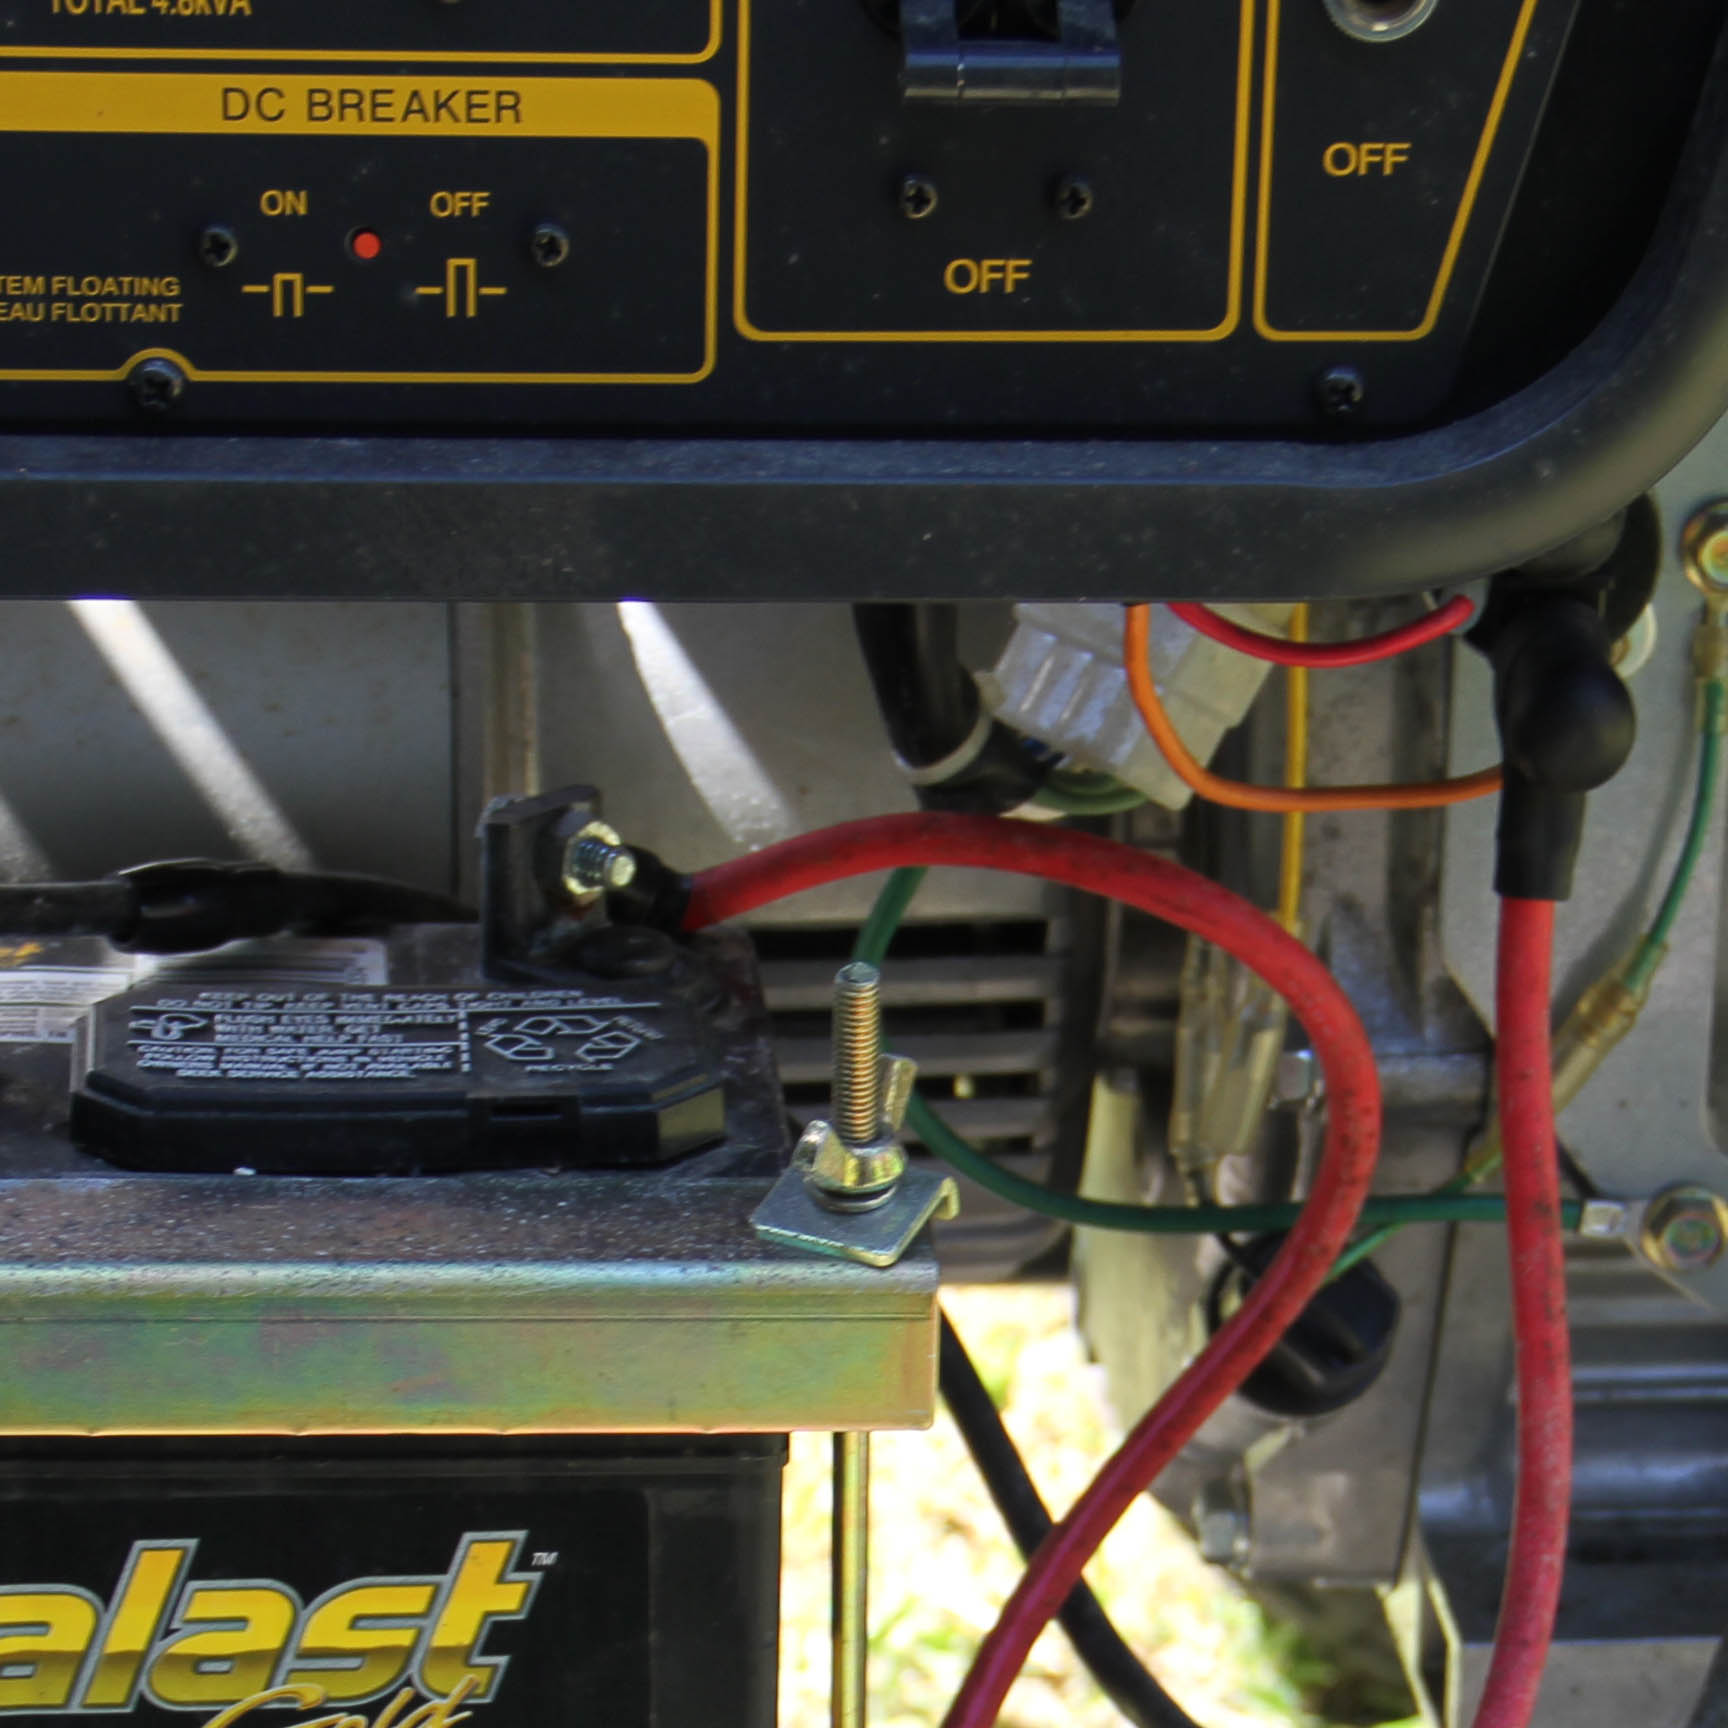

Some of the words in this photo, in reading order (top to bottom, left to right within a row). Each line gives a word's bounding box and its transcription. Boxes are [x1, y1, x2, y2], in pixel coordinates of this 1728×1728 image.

[221, 87, 285, 122] DC
[306, 89, 523, 124] BREAKER
[1322, 141, 1412, 177] OFF
[260, 190, 308, 218] ON
[429, 191, 491, 218] OFF
[50, 276, 182, 297] FLOATING
[943, 258, 1033, 294] OFF
[50, 302, 184, 323] FLOTTANT
[524, 1063, 615, 1072] RECYCLE
